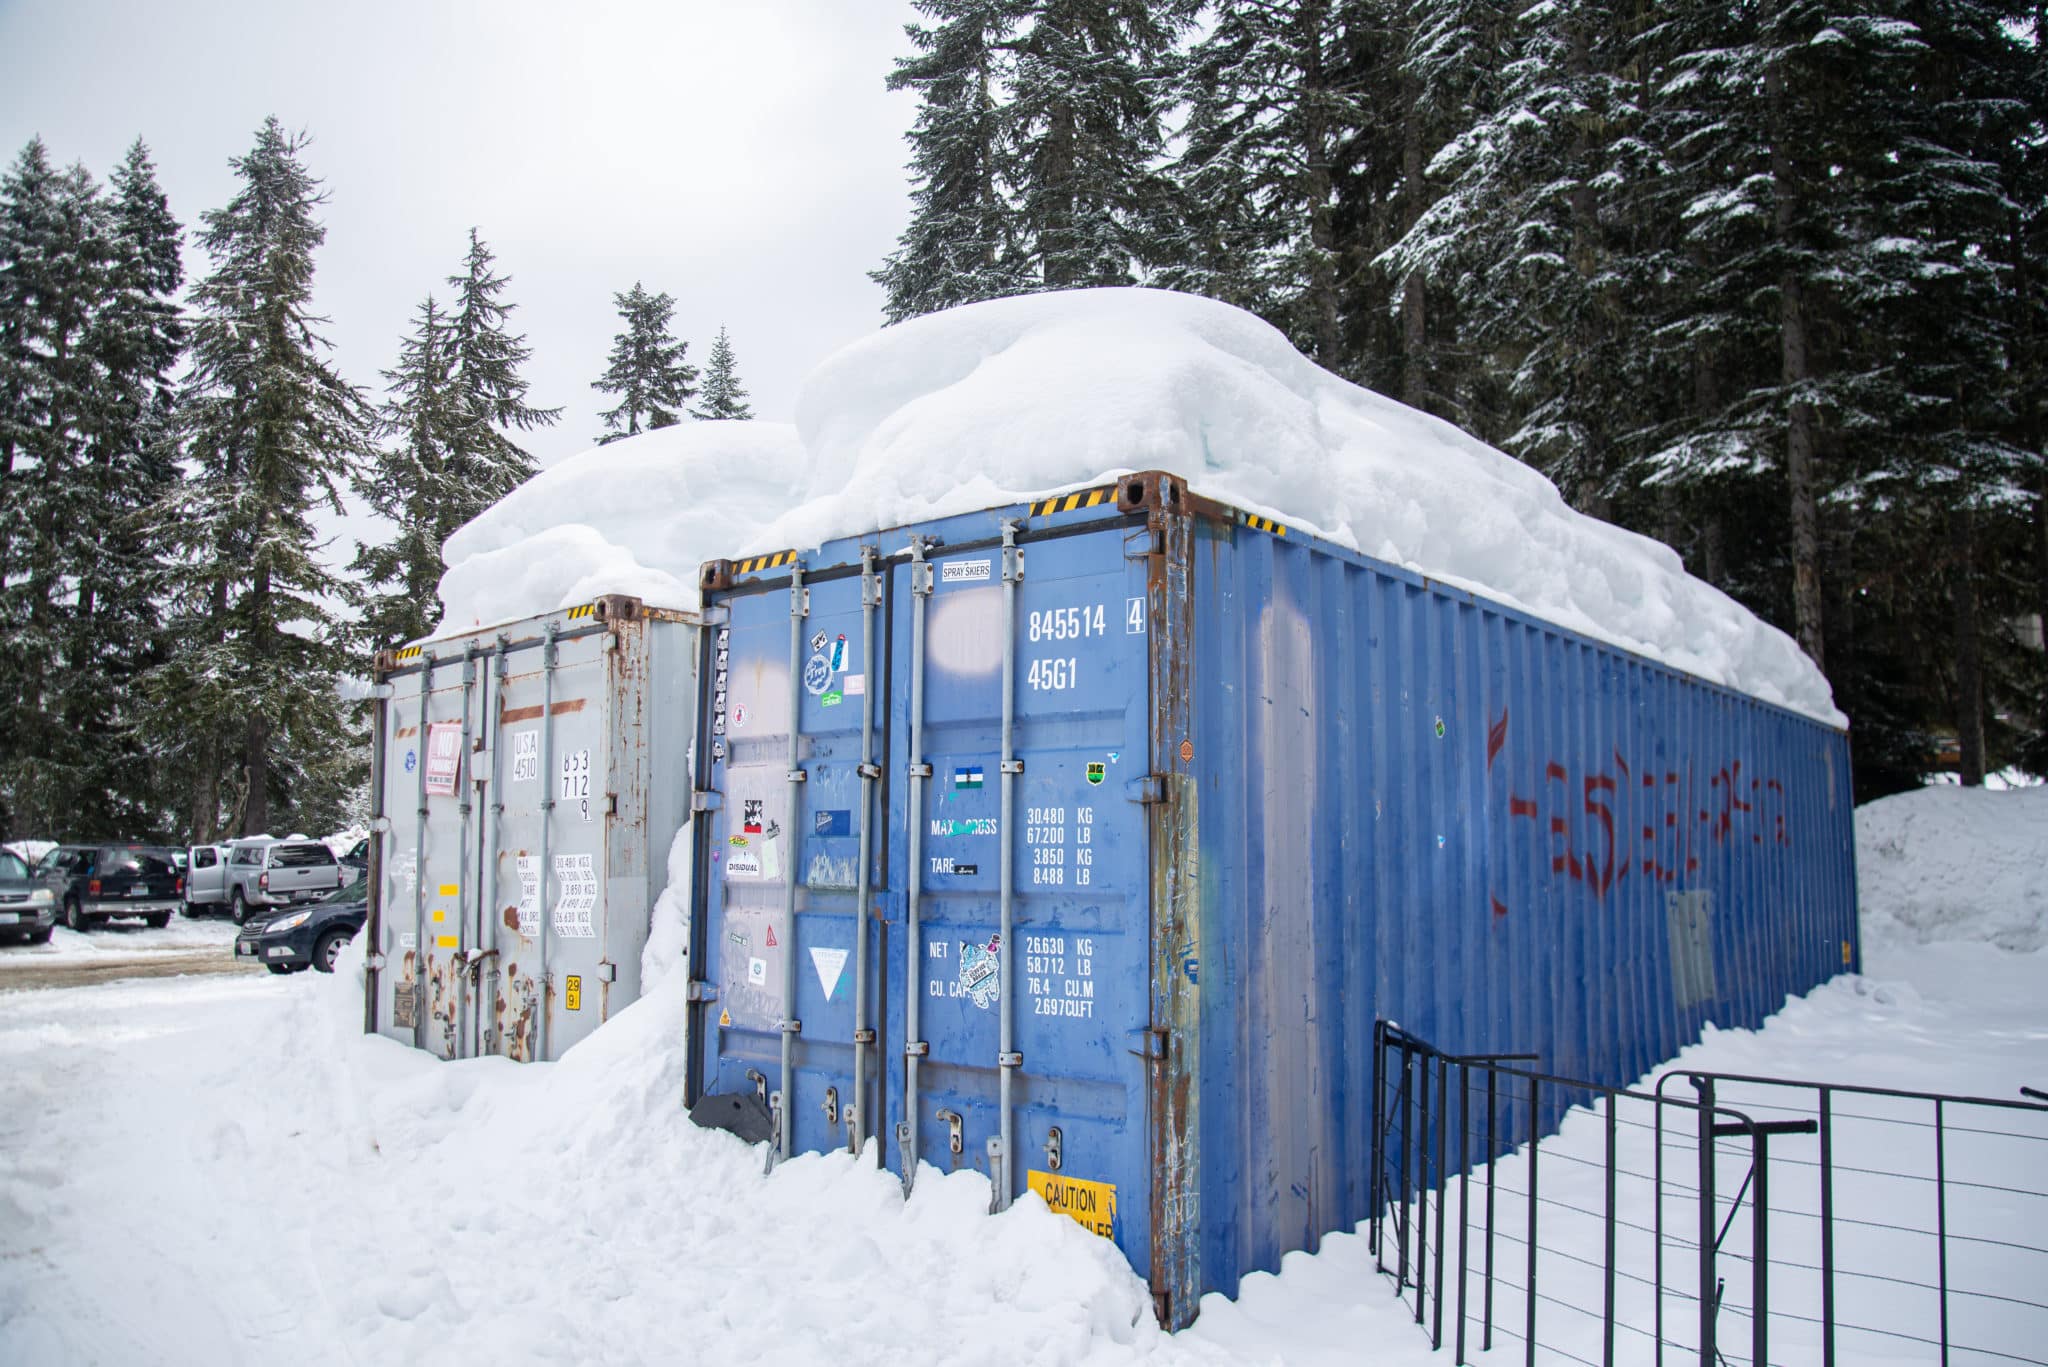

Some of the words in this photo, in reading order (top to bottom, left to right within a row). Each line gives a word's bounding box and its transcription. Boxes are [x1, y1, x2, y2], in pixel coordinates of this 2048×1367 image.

[943, 566, 965, 578] SPRAY
[965, 565, 990, 577] SKIERS
[1029, 604, 1106, 642] 845514
[1129, 599, 1143, 632] 4
[1027, 657, 1077, 690] 45G1
[516, 733, 537, 755] USA
[515, 757, 536, 778] 4510
[563, 775, 588, 797] 712
[581, 799, 588, 819] 9
[1027, 807, 1065, 825] 30.480
[1077, 807, 1093, 824] KG
[1027, 827, 1064, 844] 67.200
[1077, 827, 1091, 844] LB
[931, 857, 955, 874] TARE
[1034, 848, 1064, 865] 3.850
[1077, 848, 1092, 866] KG
[1033, 867, 1064, 885] 8.488
[1076, 868, 1090, 885] LB
[929, 942, 948, 958] NET
[1026, 937, 1064, 955] 26.630
[1077, 939, 1093, 956] KG
[1027, 957, 1065, 975] 58.712
[1077, 959, 1092, 976] LB
[930, 980, 946, 997] CU.
[1028, 978, 1050, 995] 76.4
[1065, 980, 1094, 998] CU.M
[1045, 1182, 1096, 1213] CAUTION
